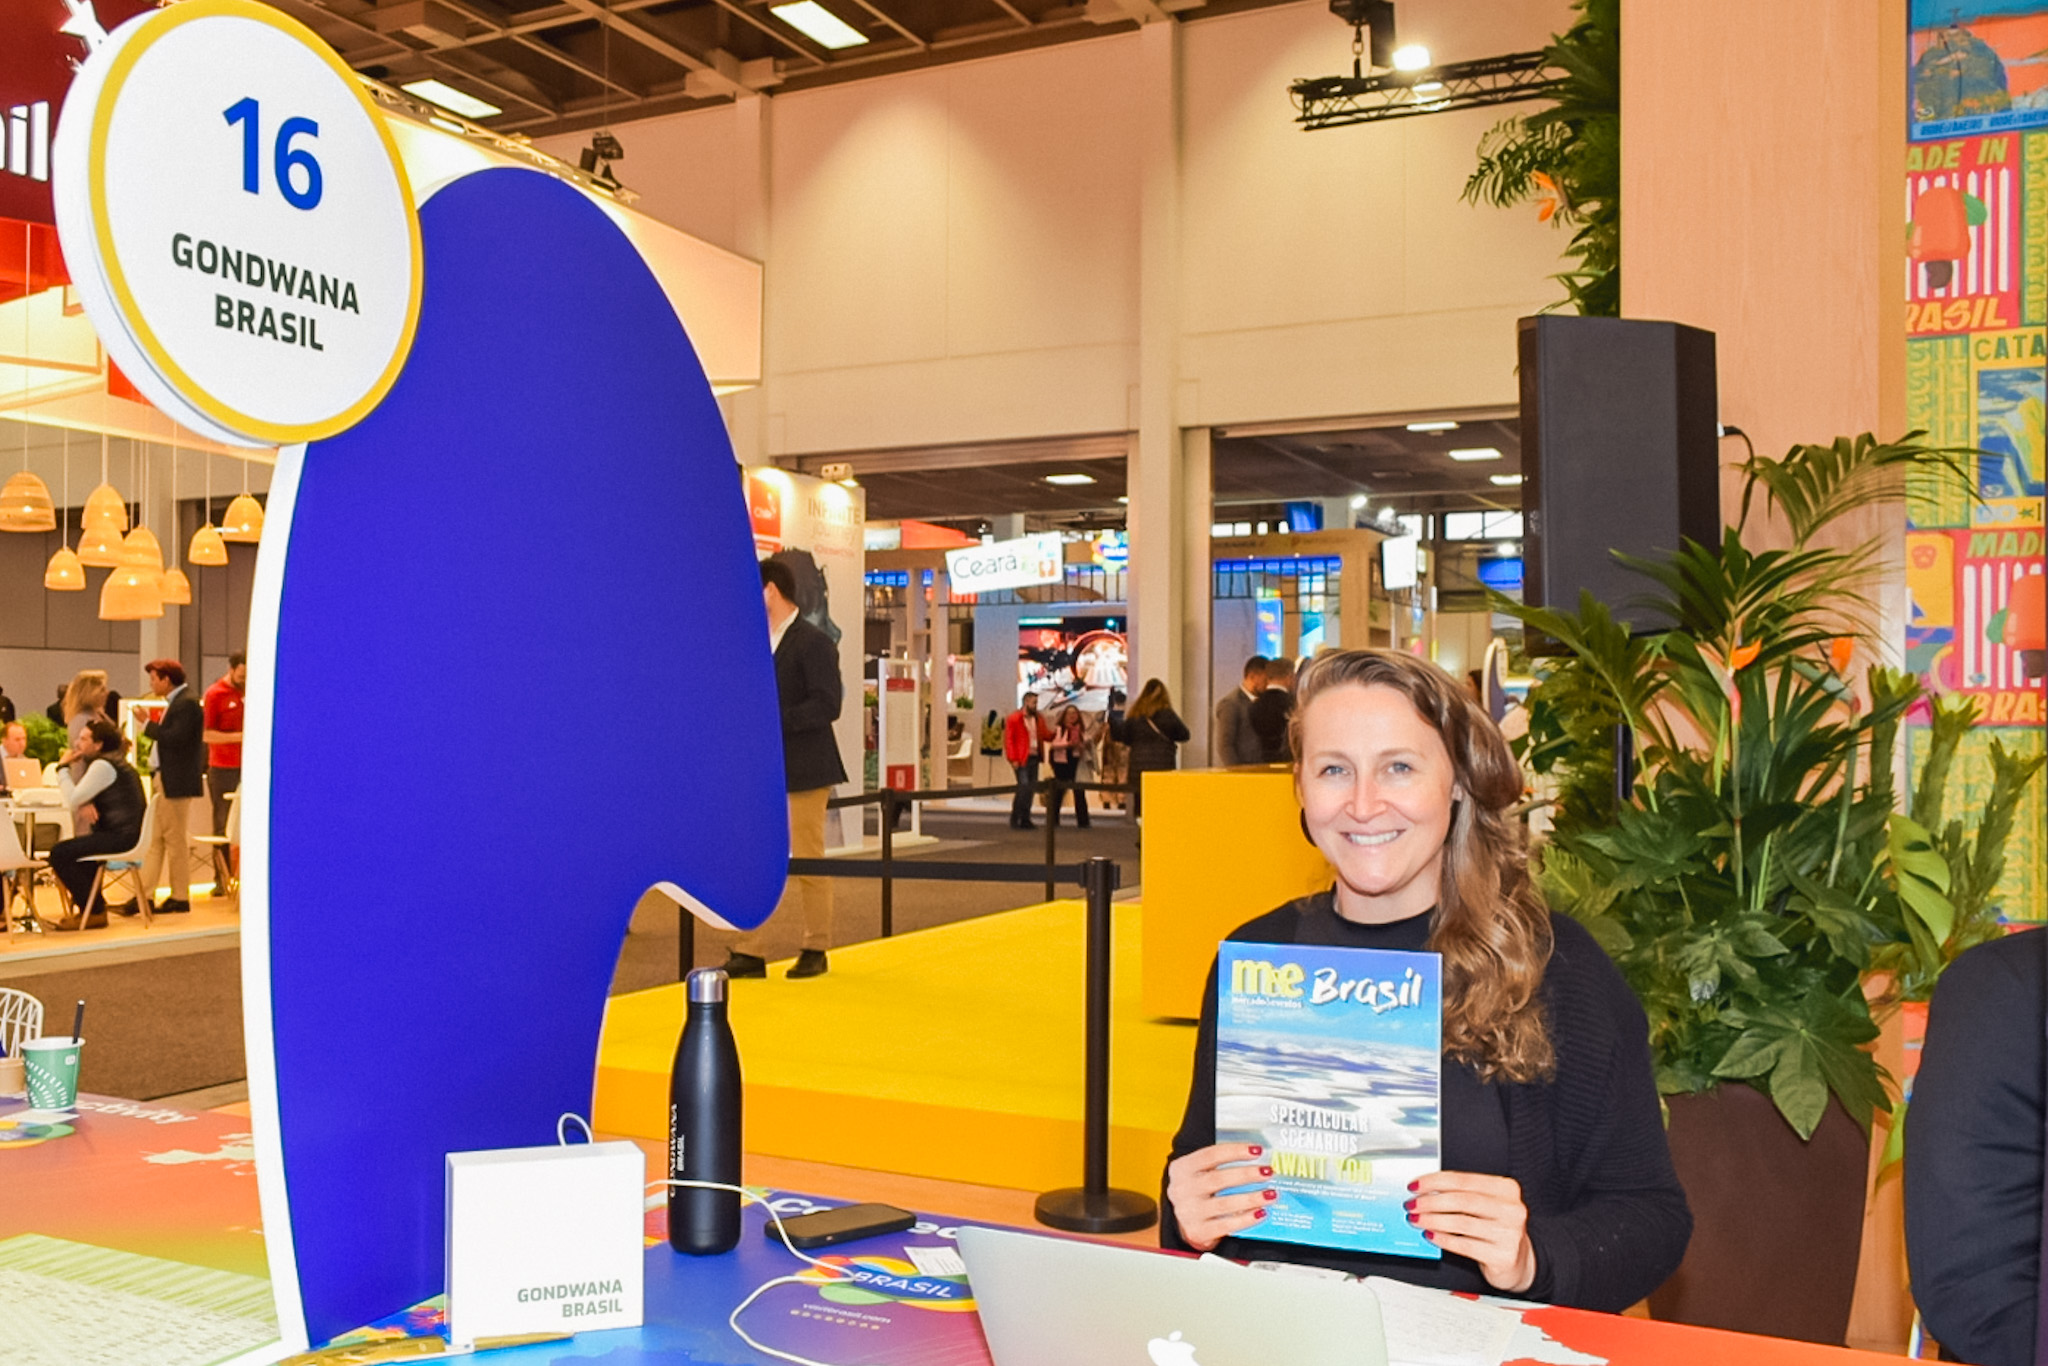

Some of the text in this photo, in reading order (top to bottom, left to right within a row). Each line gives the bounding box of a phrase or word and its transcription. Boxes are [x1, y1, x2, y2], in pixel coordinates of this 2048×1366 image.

[223, 97, 323, 211] 16
[1976, 137, 2008, 165] IN
[172, 233, 360, 315] GONDWANA
[215, 294, 324, 352] BRASIL
[1967, 531, 2046, 558] MAD
[1970, 691, 2046, 723] BRA
[1310, 967, 1423, 1015] Brasil
[1270, 1103, 1369, 1133] SPECTACULAR
[669, 1103, 678, 1198] GNDWANA
[677, 1134, 685, 1171] BRASIL
[1280, 1127, 1358, 1153] SCENARIOS
[1272, 1152, 1373, 1184] AWAIT YOU
[517, 1279, 623, 1303] GONDWANA
[854, 1270, 952, 1298] BRASIL
[562, 1298, 623, 1318] BRASIL
